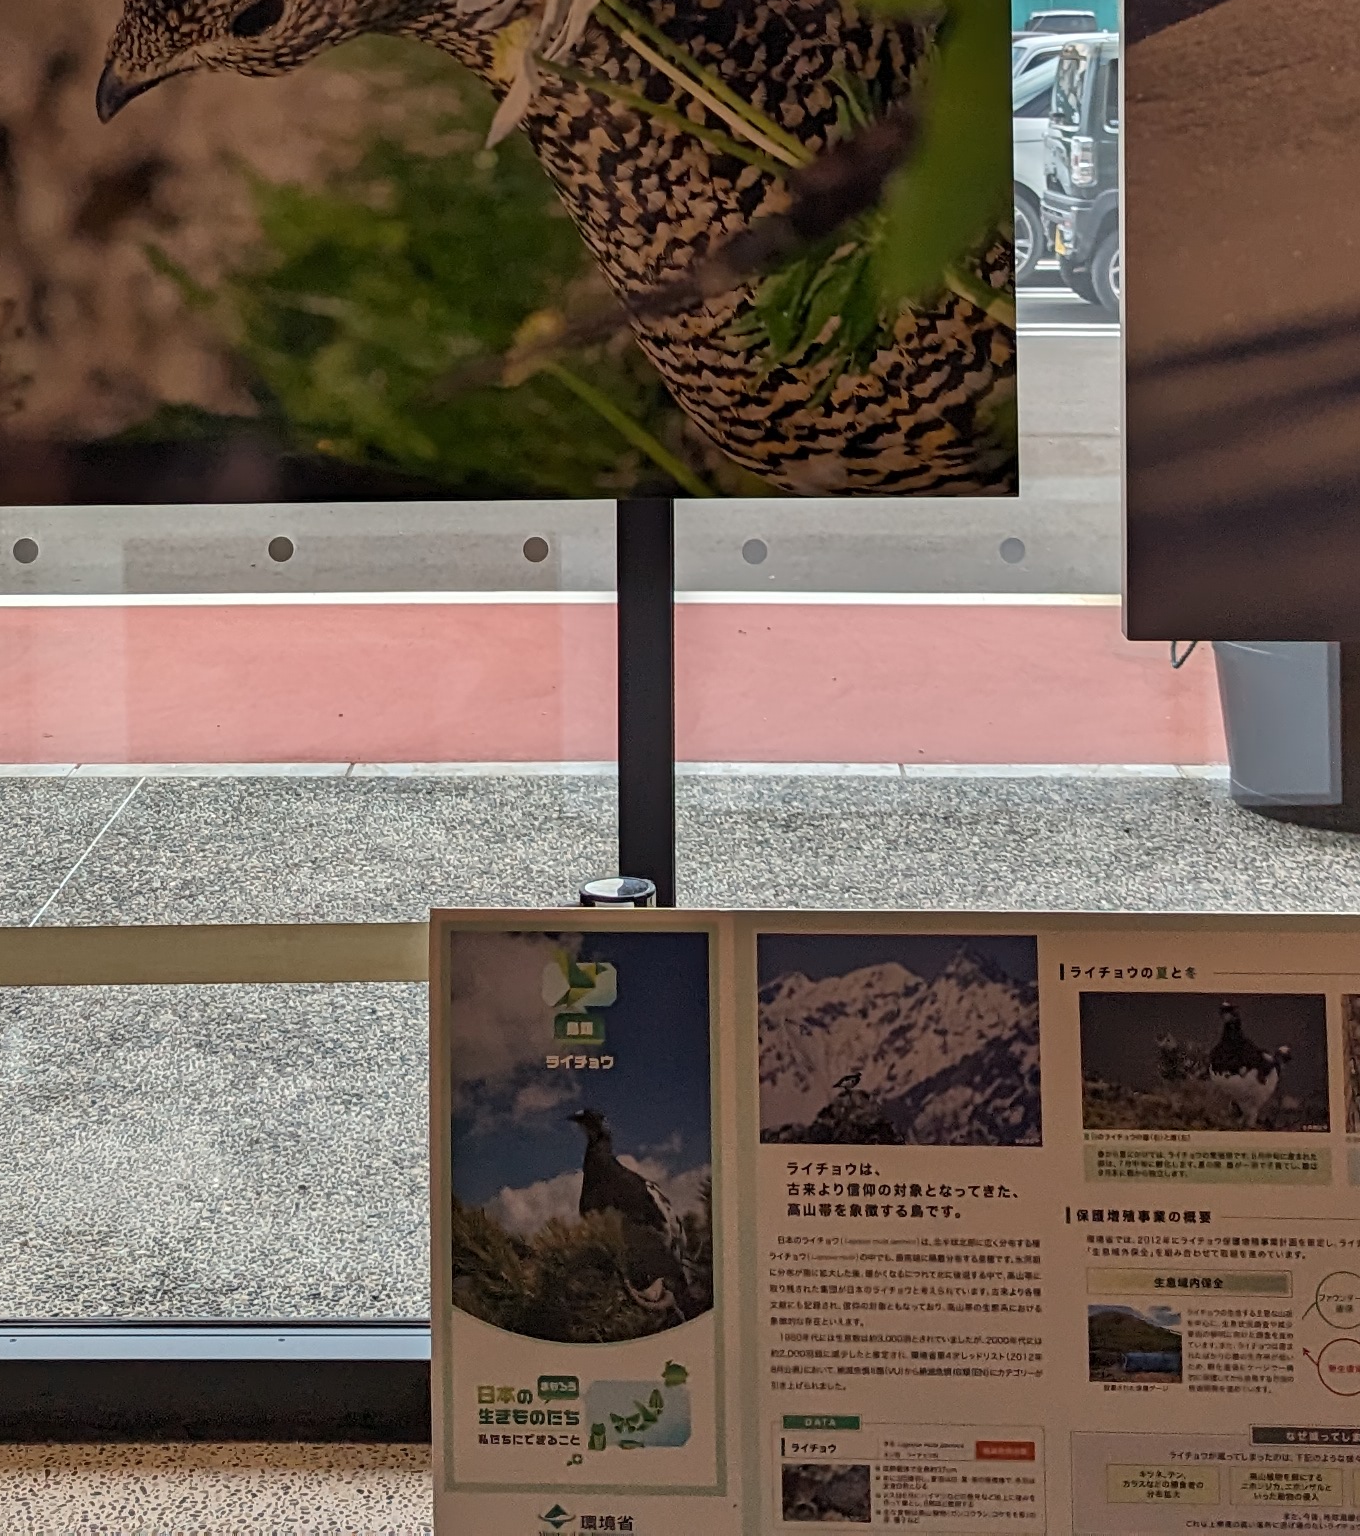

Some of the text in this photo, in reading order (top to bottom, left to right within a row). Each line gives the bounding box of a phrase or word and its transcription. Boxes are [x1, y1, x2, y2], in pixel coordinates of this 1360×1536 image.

[1070, 966, 1196, 980] ライチョウの夏と冬
[546, 1054, 614, 1069] ライチョウ
[787, 1162, 881, 1176] ライチョウは、
[787, 1183, 1019, 1199] 古来より信仰の対象となってきた、
[787, 1203, 962, 1219] 高山帯を象徴する鳥です。
[478, 1408, 580, 1426] 生きものたち
[805, 1418, 836, 1427] DATA
[478, 1433, 581, 1446] 私たちにできること
[791, 1443, 837, 1454] ライチョウ
[580, 1515, 634, 1532] 環境省
